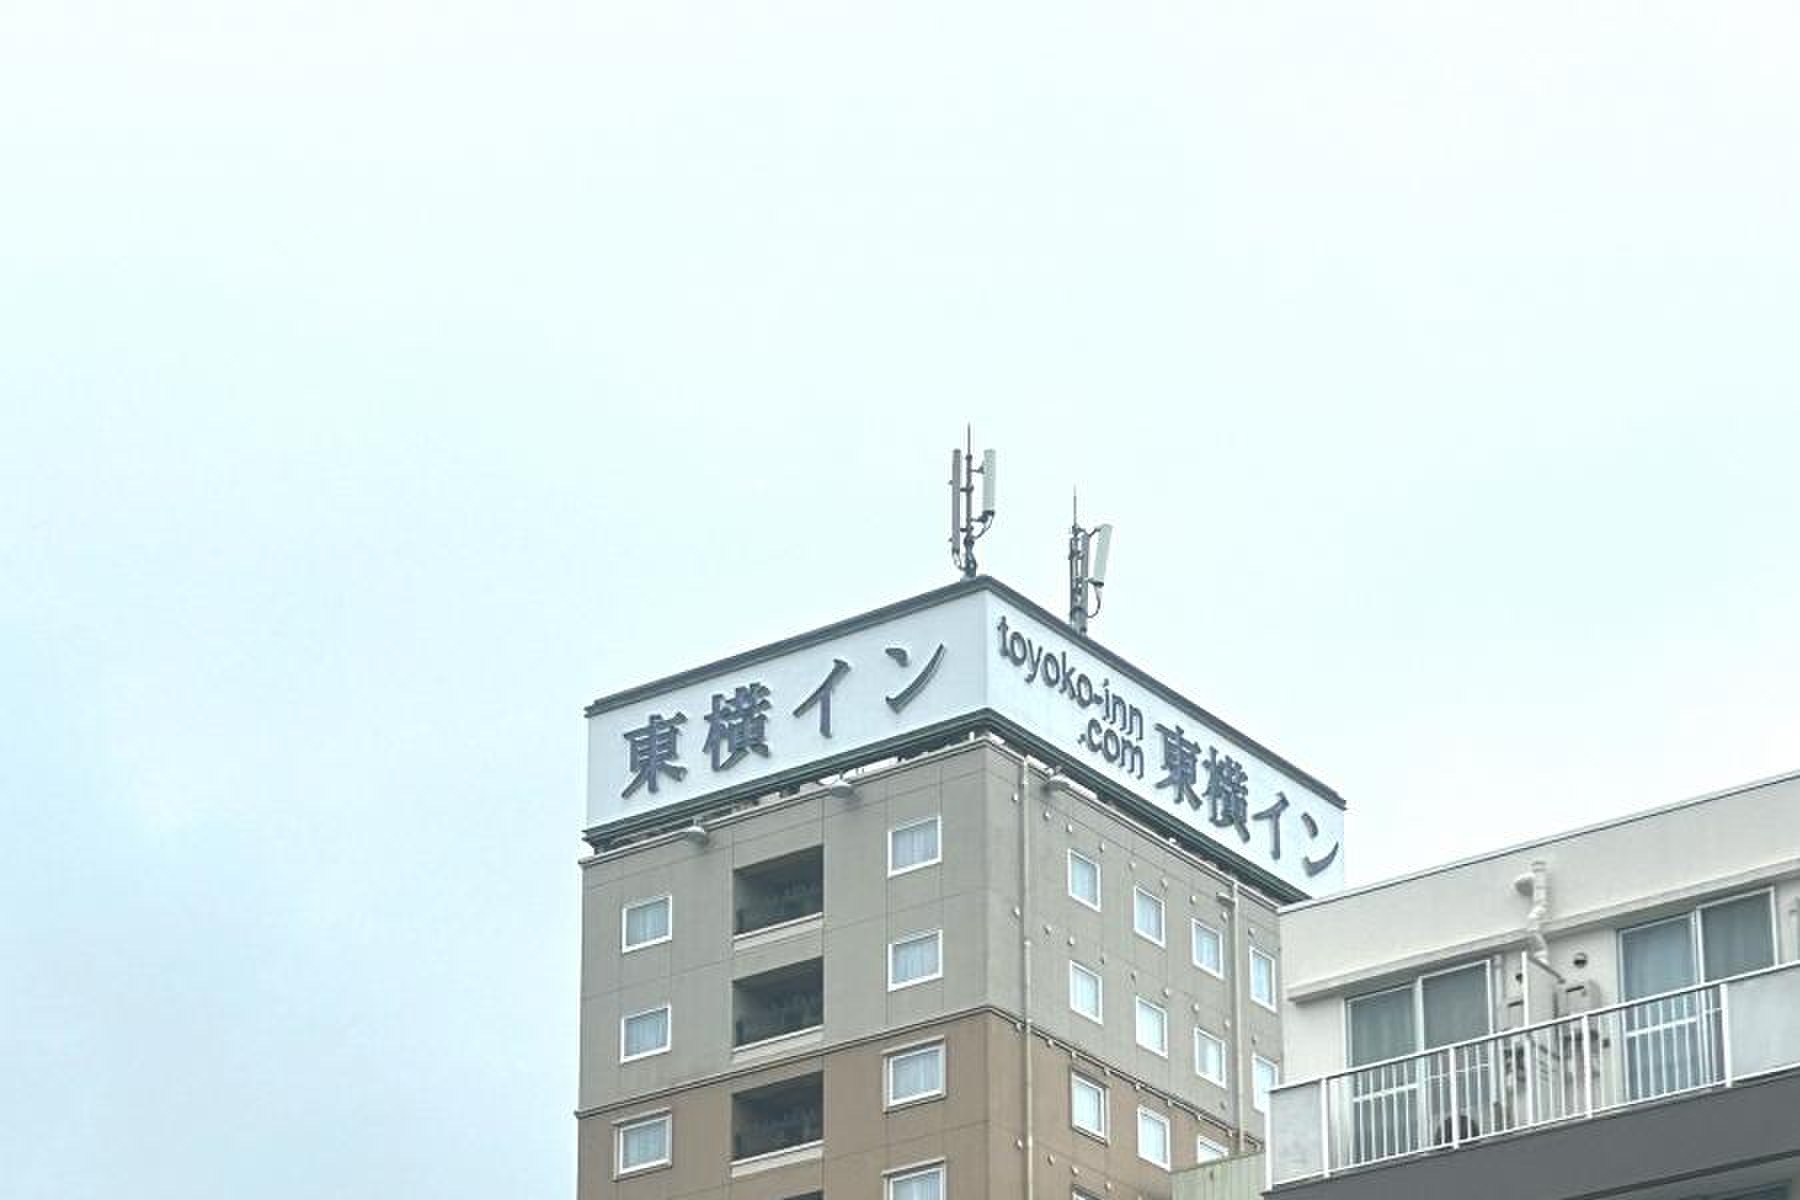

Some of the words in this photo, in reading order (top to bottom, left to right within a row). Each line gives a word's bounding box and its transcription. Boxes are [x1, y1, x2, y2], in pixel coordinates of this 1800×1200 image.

[622, 643, 946, 798] 東横イン
[997, 615, 1144, 741] toyoko-inn
[1077, 718, 1144, 780] .com
[1154, 722, 1340, 878] 東横イン
